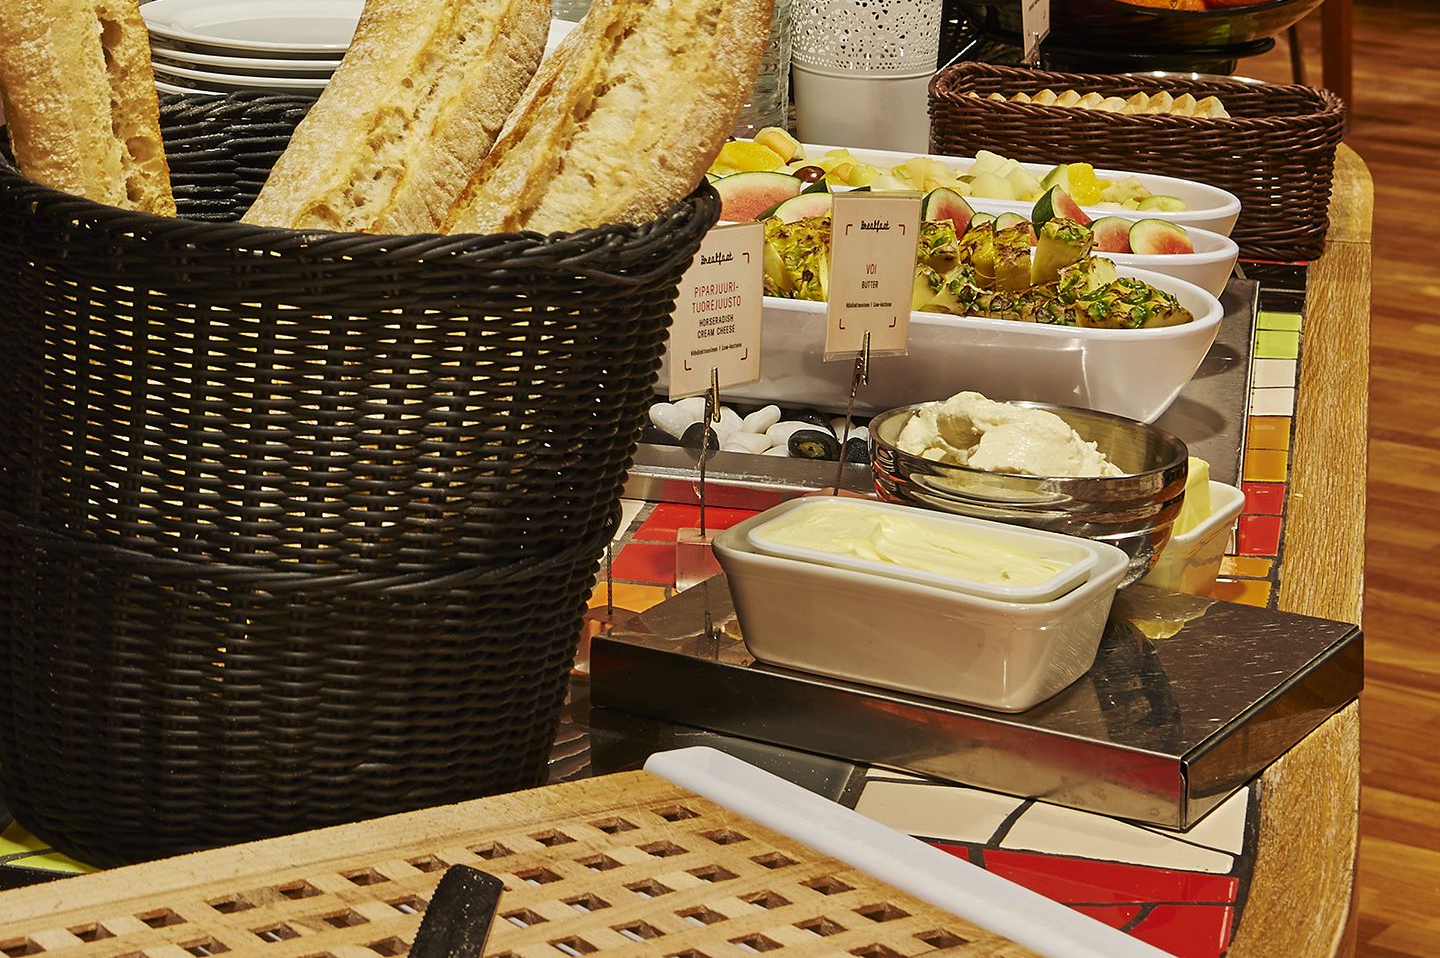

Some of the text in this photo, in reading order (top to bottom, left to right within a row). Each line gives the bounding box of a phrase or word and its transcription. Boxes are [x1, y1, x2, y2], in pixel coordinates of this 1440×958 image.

[700, 251, 734, 266] Breakfast
[866, 263, 877, 275] VOI
[694, 282, 739, 298] PIPARJUURI-
[861, 280, 879, 290] BUTTER
[692, 295, 742, 314] TUOREJUUSTO
[699, 314, 734, 327] HORSERADISH
[697, 324, 735, 339] CREAM CHEESE
